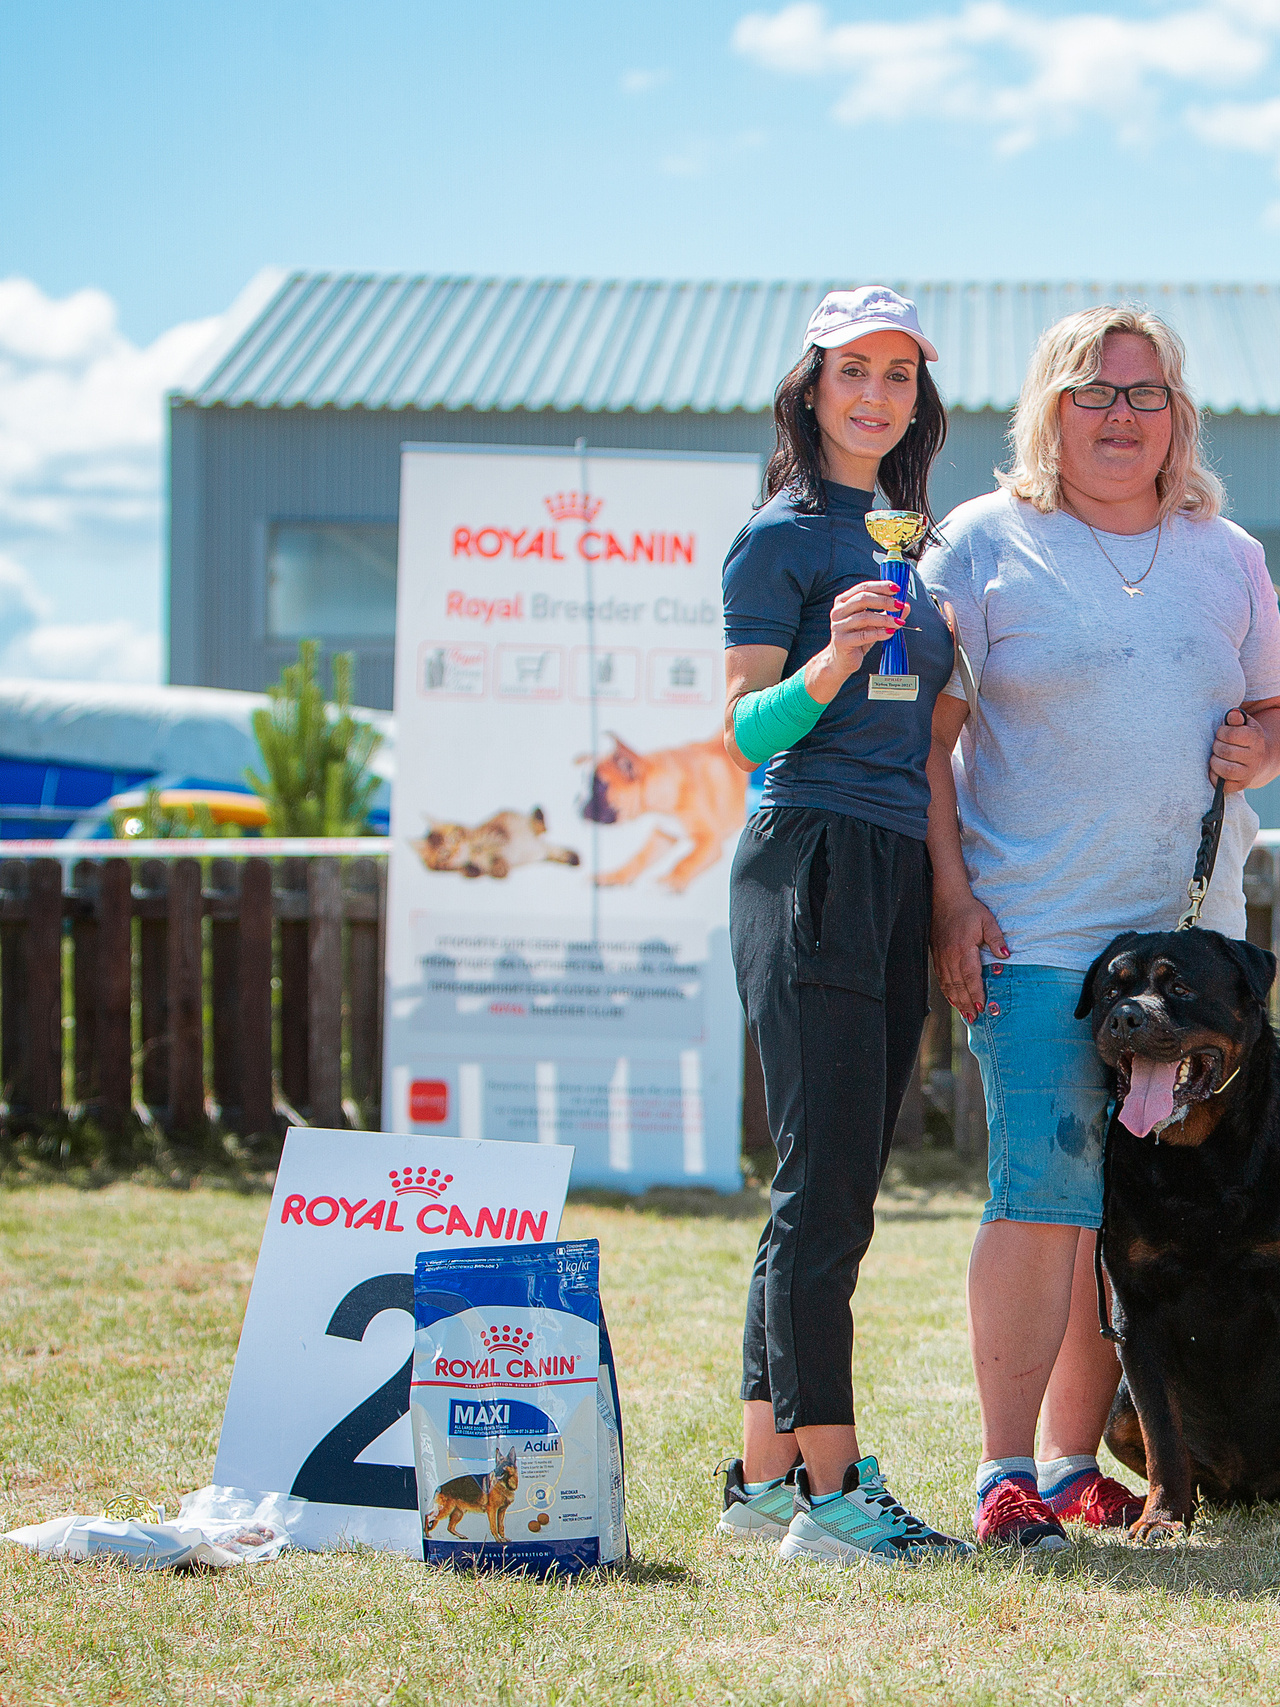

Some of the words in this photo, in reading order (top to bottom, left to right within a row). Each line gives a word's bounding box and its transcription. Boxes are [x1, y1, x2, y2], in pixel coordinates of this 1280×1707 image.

[453, 528, 564, 560] ROYAL
[578, 531, 693, 563] CANIN
[447, 591, 523, 622] Royal
[531, 594, 646, 622] Breeder
[654, 597, 716, 624] Club
[281, 1194, 405, 1232] ROYAL
[416, 1203, 548, 1242] CANIN
[556, 1261, 563, 1273] 3
[435, 1358, 500, 1378] ROYAL
[288, 1273, 417, 1510] 2
[454, 1404, 510, 1425] MAXI
[524, 1440, 558, 1452] Adult
